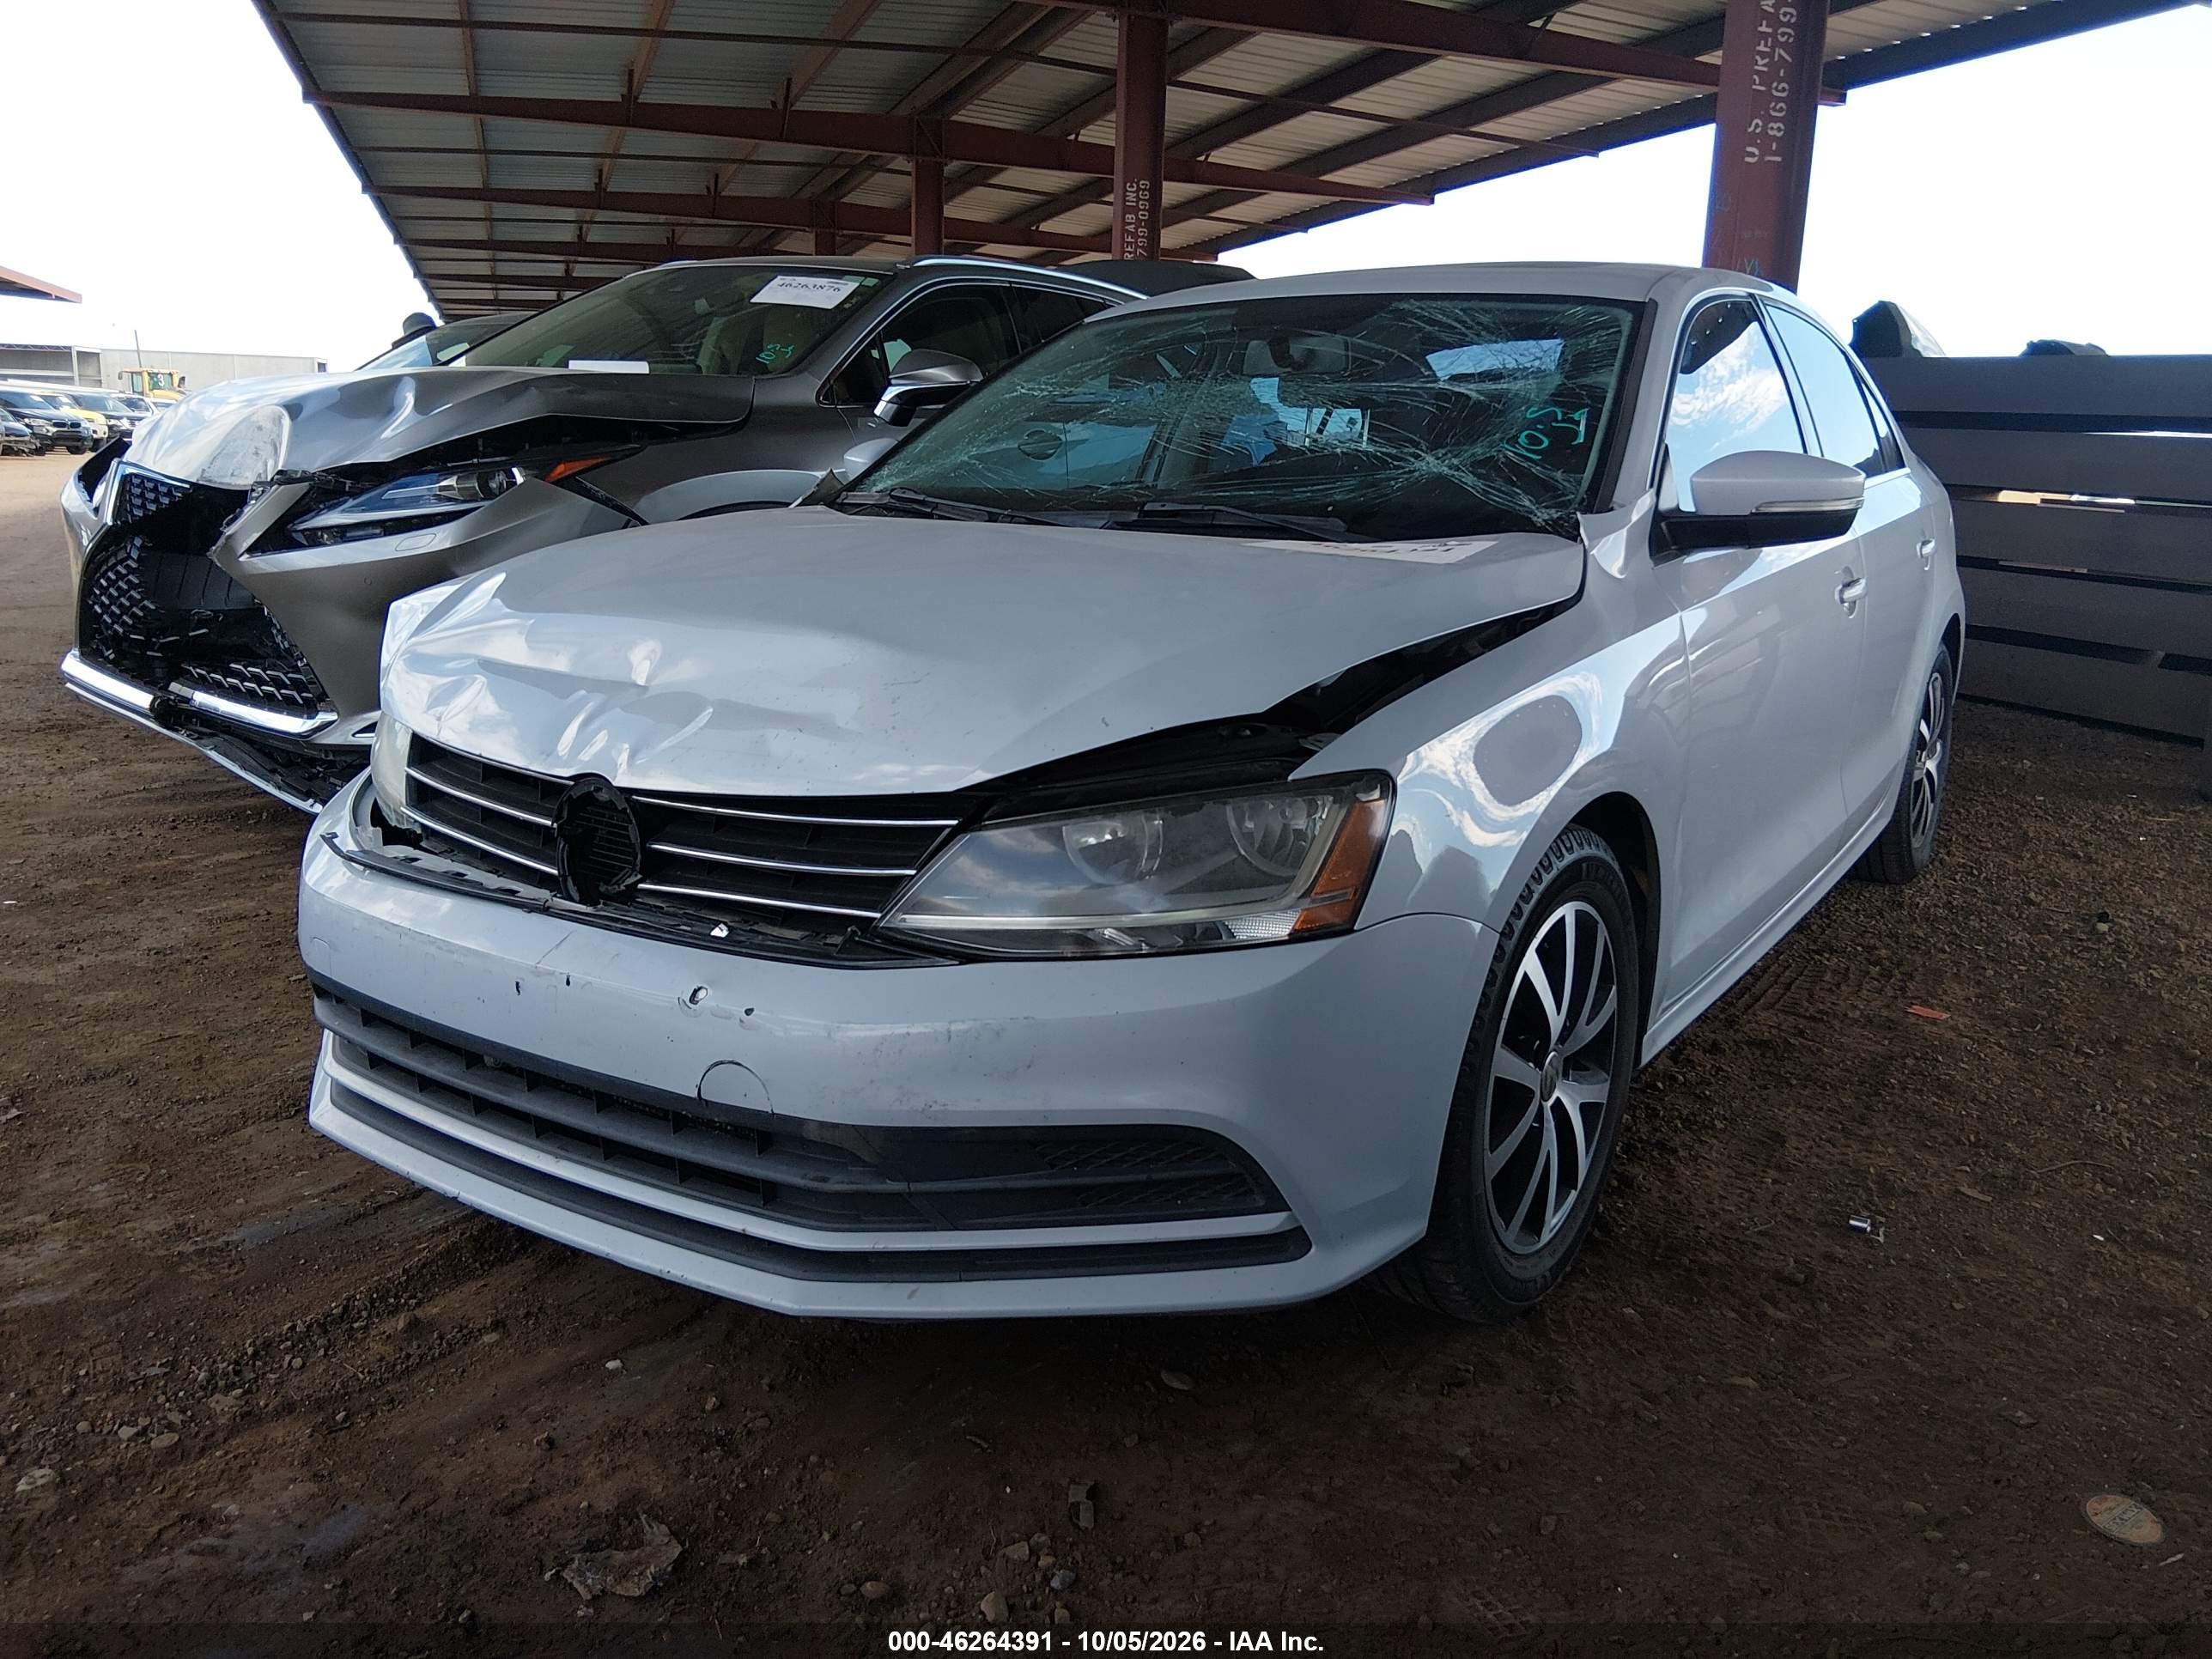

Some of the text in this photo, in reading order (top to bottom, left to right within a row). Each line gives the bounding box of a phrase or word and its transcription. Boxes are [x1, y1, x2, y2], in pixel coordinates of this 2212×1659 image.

[1764, 0, 1797, 161] 1-866-799
[1744, 111, 1764, 163] U.S.
[1126, 178, 1138, 206] INC.
